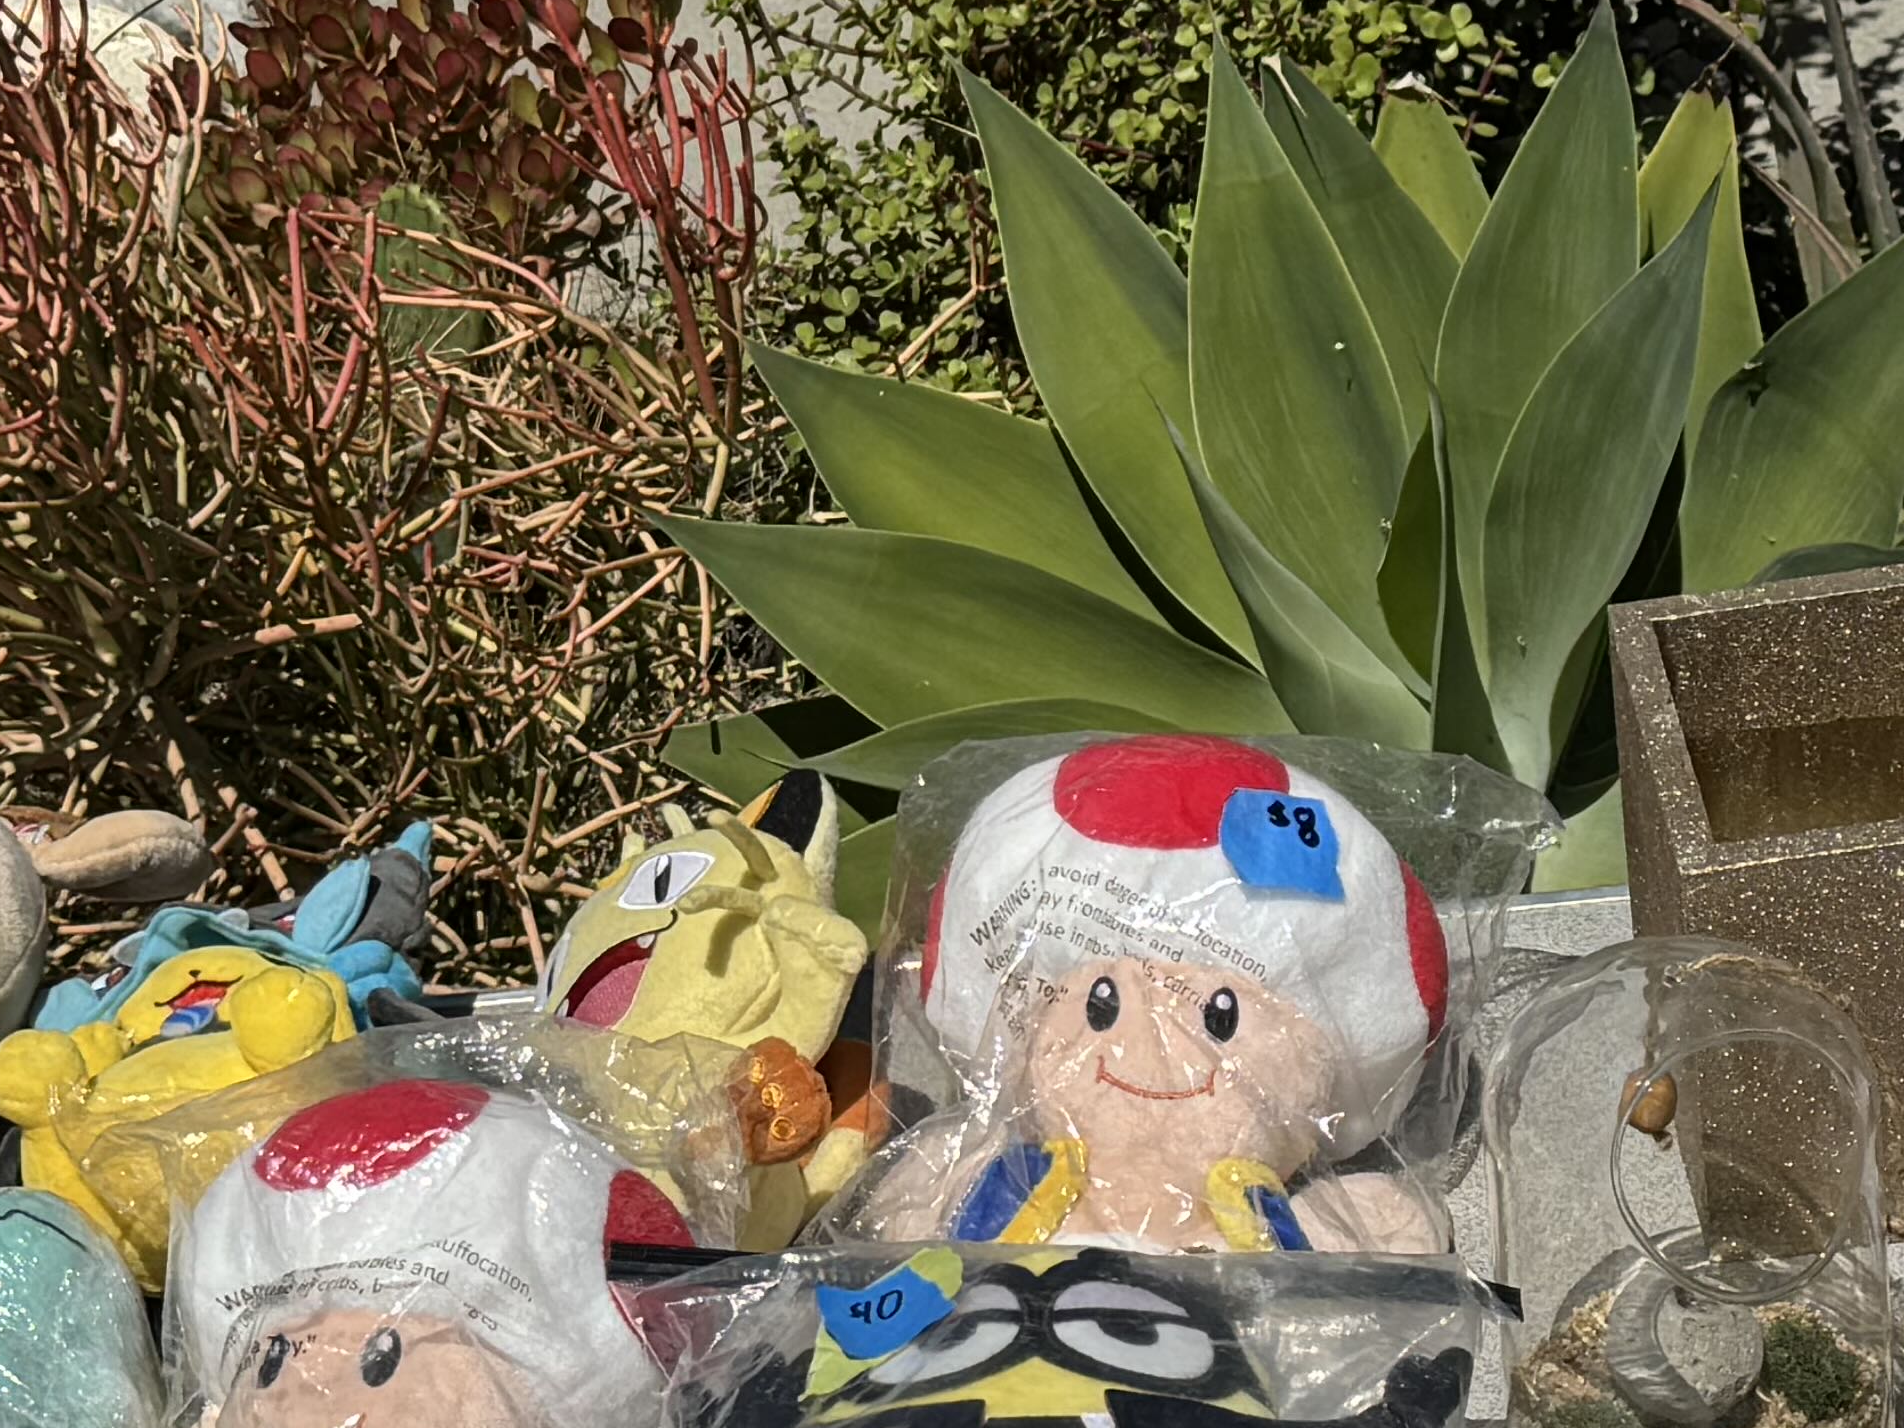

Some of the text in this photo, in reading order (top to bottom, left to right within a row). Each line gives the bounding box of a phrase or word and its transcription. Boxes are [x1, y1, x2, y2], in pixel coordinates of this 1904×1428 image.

[1048, 863, 1100, 887] avoid
[969, 878, 1038, 947] WARNING:
[1149, 936, 1184, 963] and
[409, 1259, 450, 1285] and
